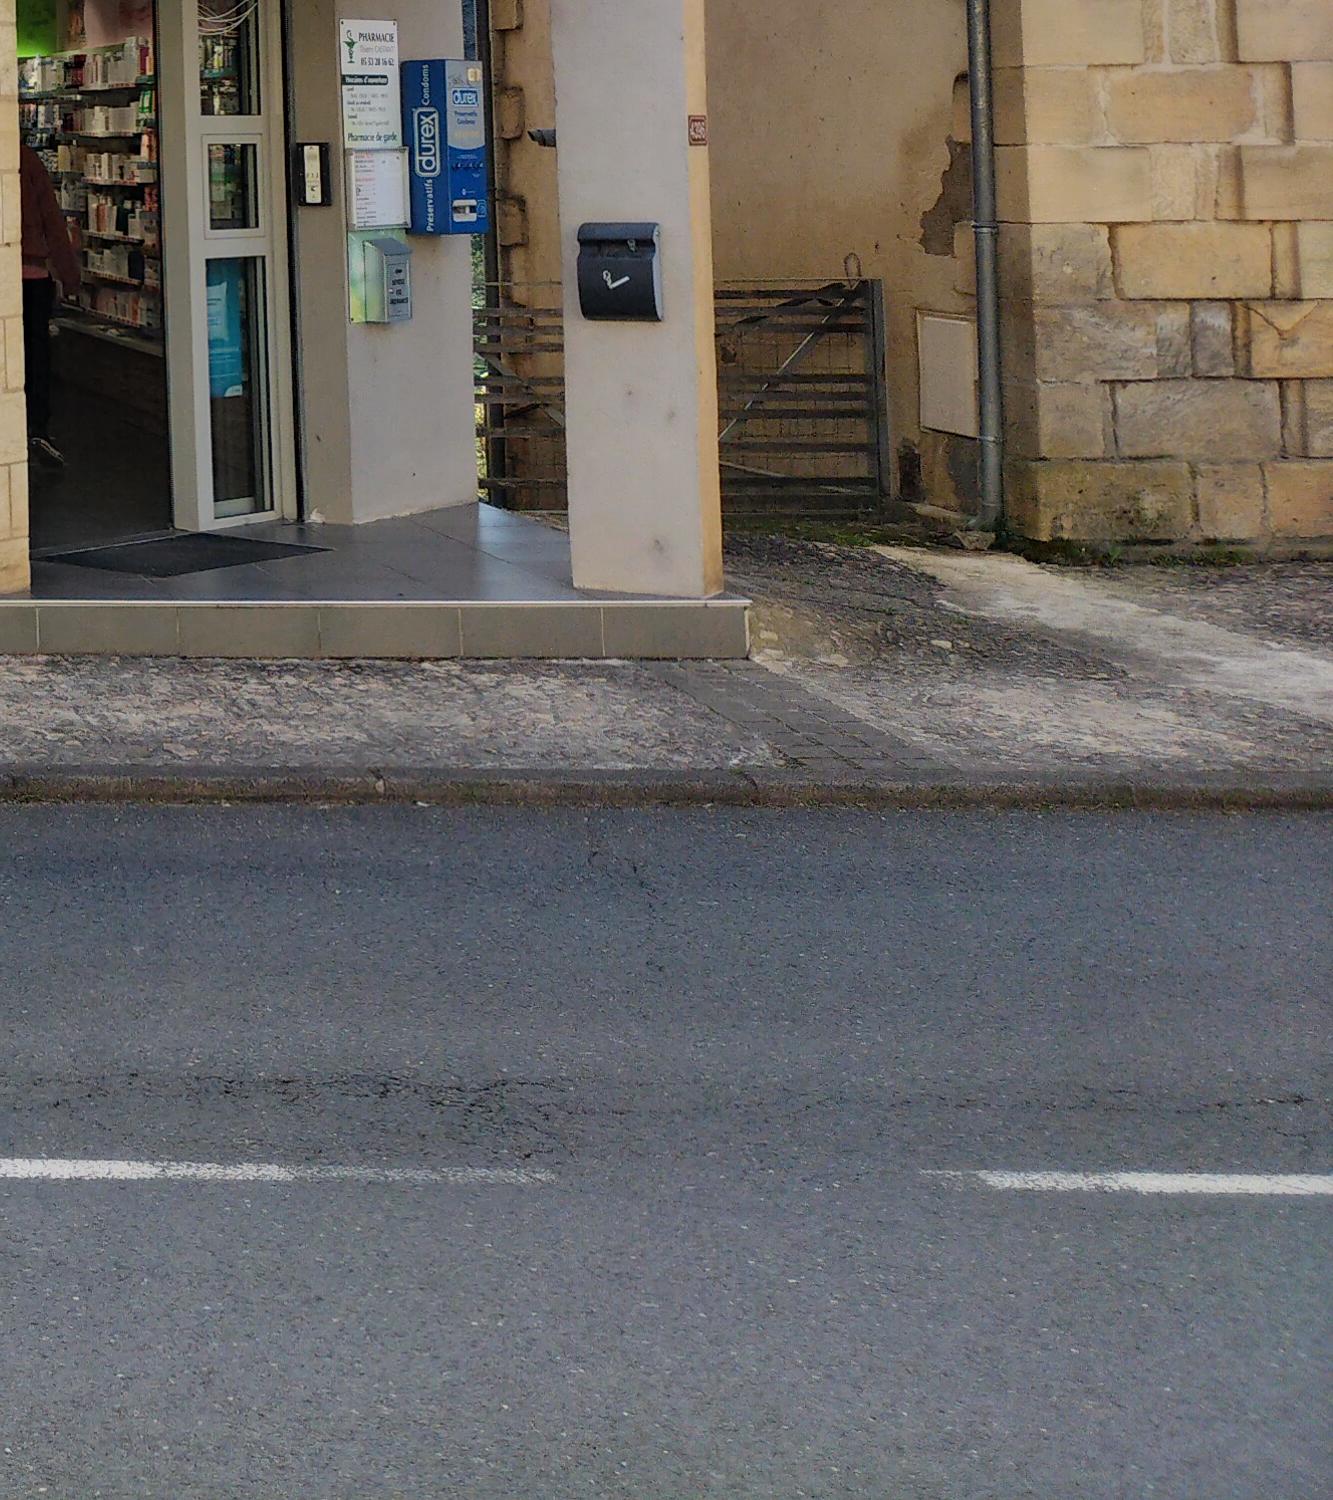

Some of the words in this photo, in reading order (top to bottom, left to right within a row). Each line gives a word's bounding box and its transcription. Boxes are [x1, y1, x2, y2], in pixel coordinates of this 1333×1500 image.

[358, 32, 394, 42] PHARMACIE
[421, 64, 430, 106] Condoms
[452, 89, 477, 104] durex
[376, 132, 382, 141] de
[417, 112, 437, 172] durex
[422, 179, 435, 232] Préservatifs
